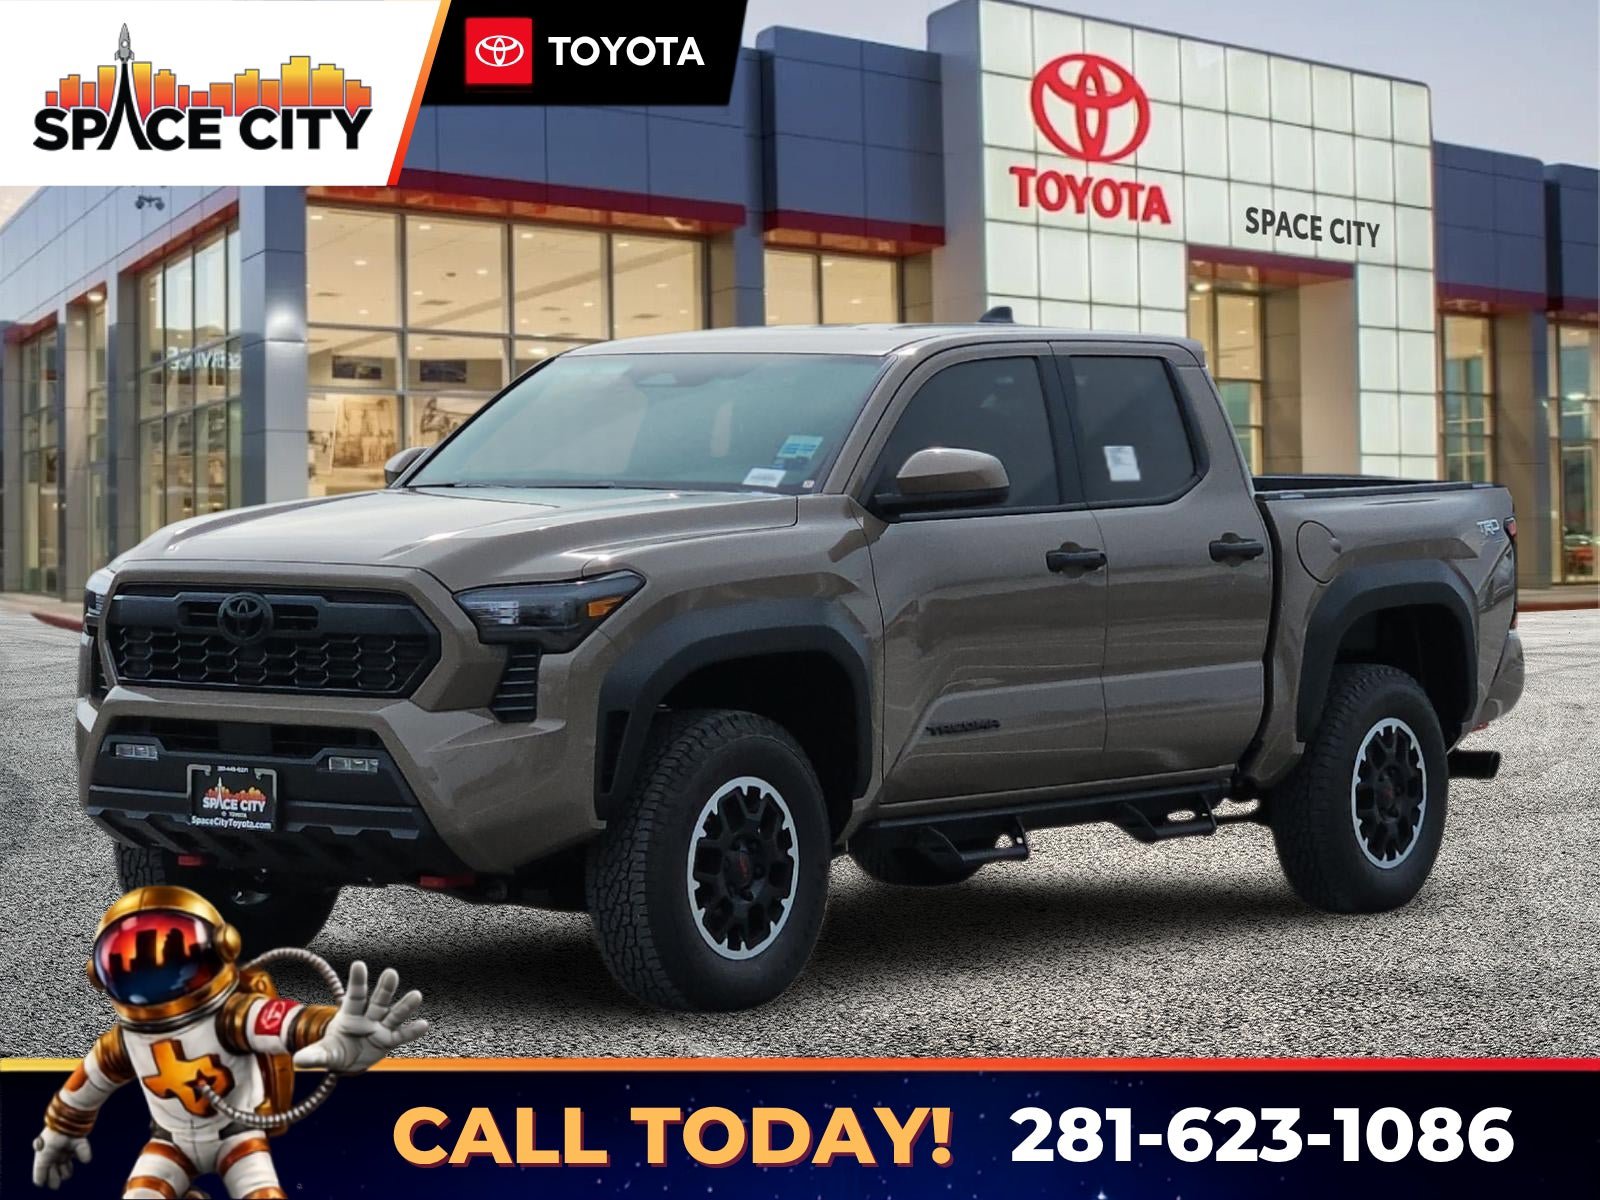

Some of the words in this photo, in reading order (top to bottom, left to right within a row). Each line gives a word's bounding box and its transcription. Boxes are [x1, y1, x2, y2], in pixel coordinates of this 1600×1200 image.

[1009, 166, 1171, 224] TOYOTA
[1245, 206, 1323, 242] SPACE
[1329, 217, 1381, 248] CITY
[1476, 518, 1500, 536] TRD
[202, 796, 239, 811] SPACE
[239, 800, 267, 813] CITY
[191, 815, 272, 830] SpaceCityToyota.com
